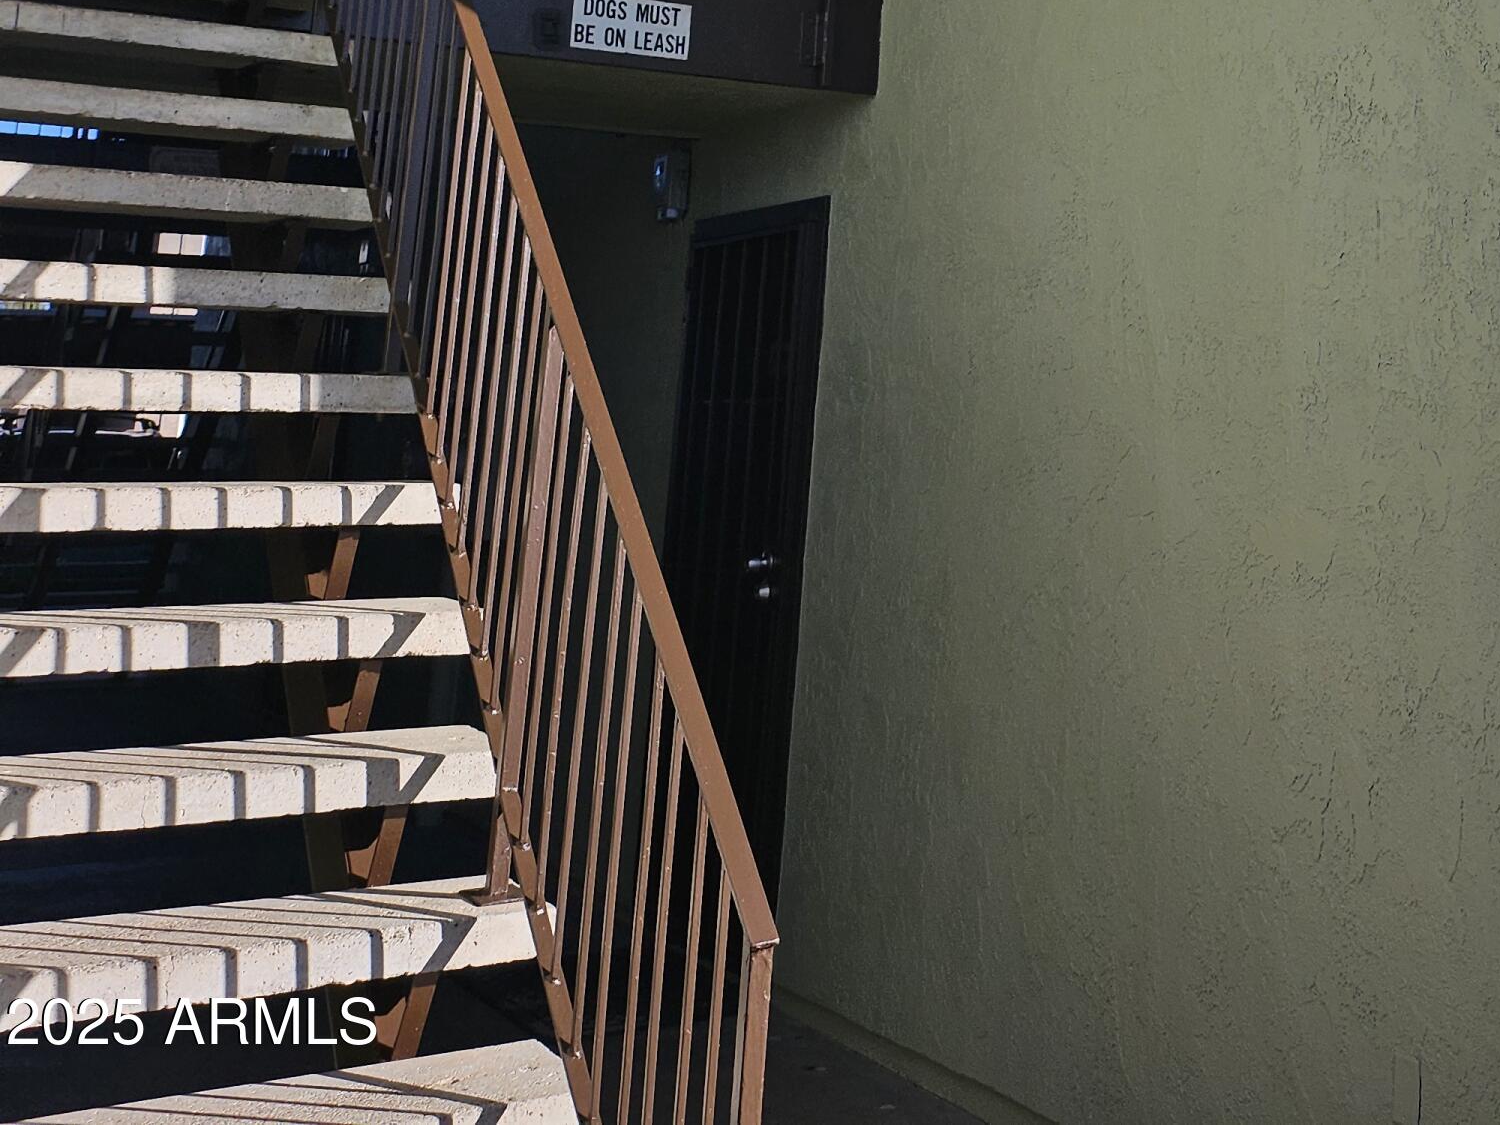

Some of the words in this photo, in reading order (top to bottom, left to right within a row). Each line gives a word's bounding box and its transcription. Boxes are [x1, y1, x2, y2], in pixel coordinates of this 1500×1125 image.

[635, 2, 682, 27] MUST
[574, 23, 596, 44] BE
[604, 27, 626, 48] ON
[634, 30, 686, 55] LEASH
